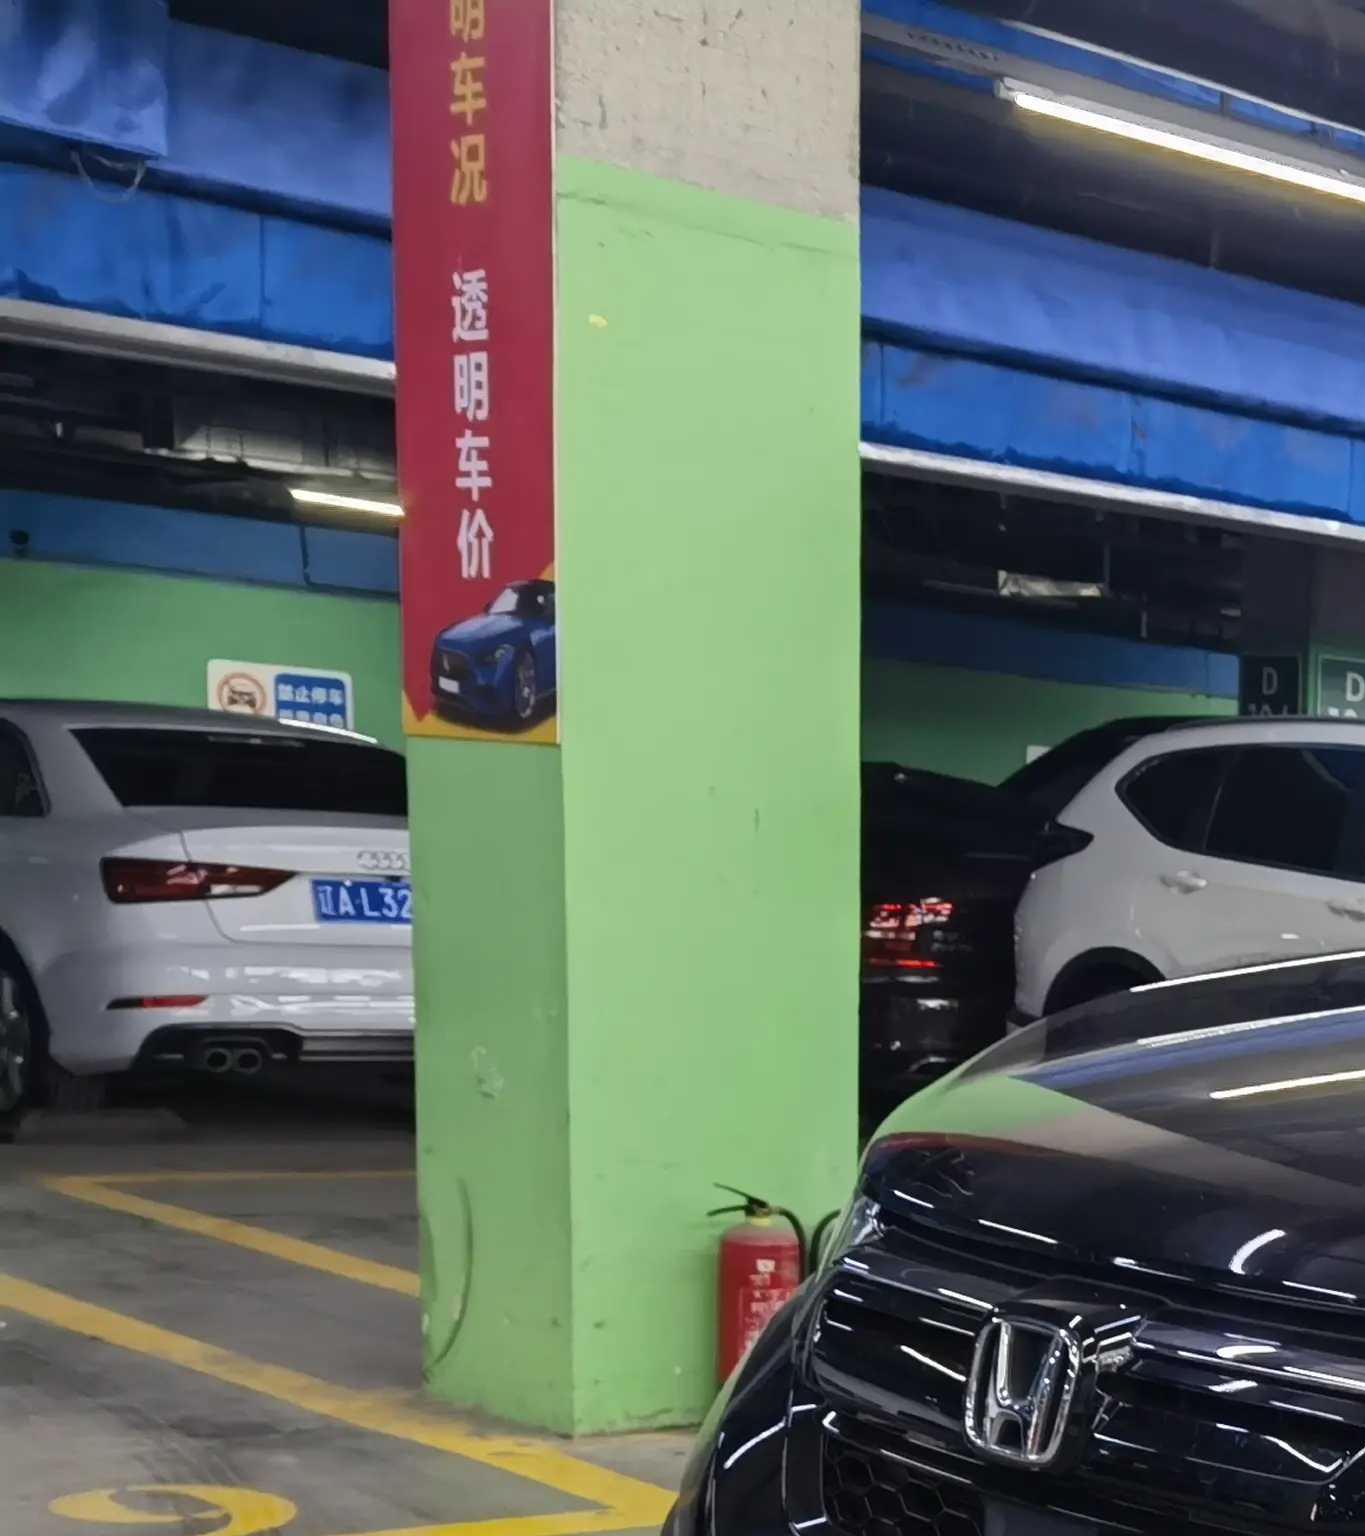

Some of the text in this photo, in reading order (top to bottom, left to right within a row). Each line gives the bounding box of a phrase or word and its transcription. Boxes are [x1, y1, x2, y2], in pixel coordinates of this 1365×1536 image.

[452, 268, 494, 580] 透明车价
[1262, 666, 1279, 696] D
